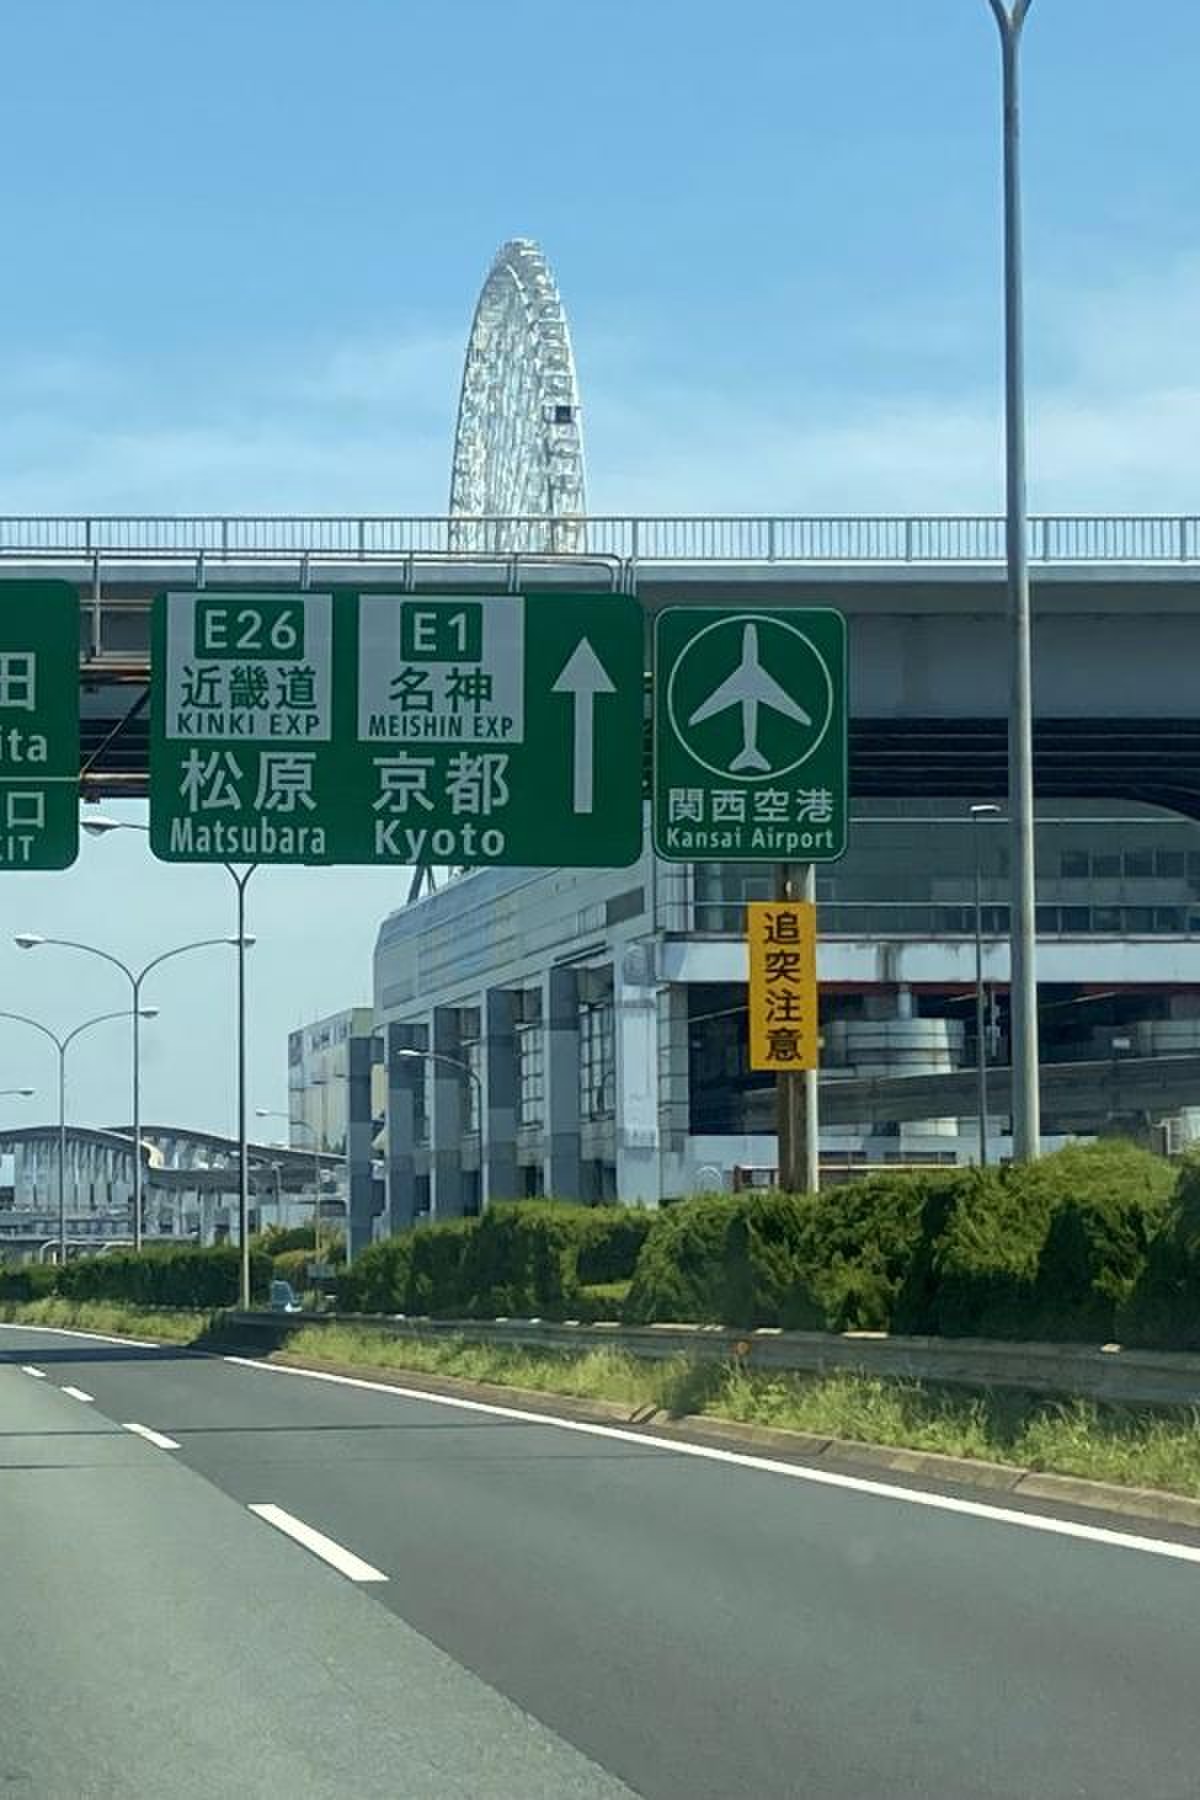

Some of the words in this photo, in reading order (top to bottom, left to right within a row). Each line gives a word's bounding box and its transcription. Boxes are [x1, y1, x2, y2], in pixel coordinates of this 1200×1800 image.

[206, 610, 297, 650] E26
[414, 613, 467, 652] E1
[181, 666, 317, 711] 近畿道
[390, 667, 492, 712] 名神
[178, 713, 255, 735] KINKI
[270, 714, 320, 736] EXP
[369, 714, 462, 737] MEISHIN
[474, 714, 512, 738] EXP
[180, 749, 317, 813] 松原
[372, 751, 509, 815] 京都
[669, 788, 834, 823] 関西空港
[171, 816, 326, 855] Matsubara
[375, 820, 505, 864] Kyoto
[667, 827, 741, 849] Kansai
[752, 827, 834, 852] Airport
[764, 911, 803, 1063] 追突注意
